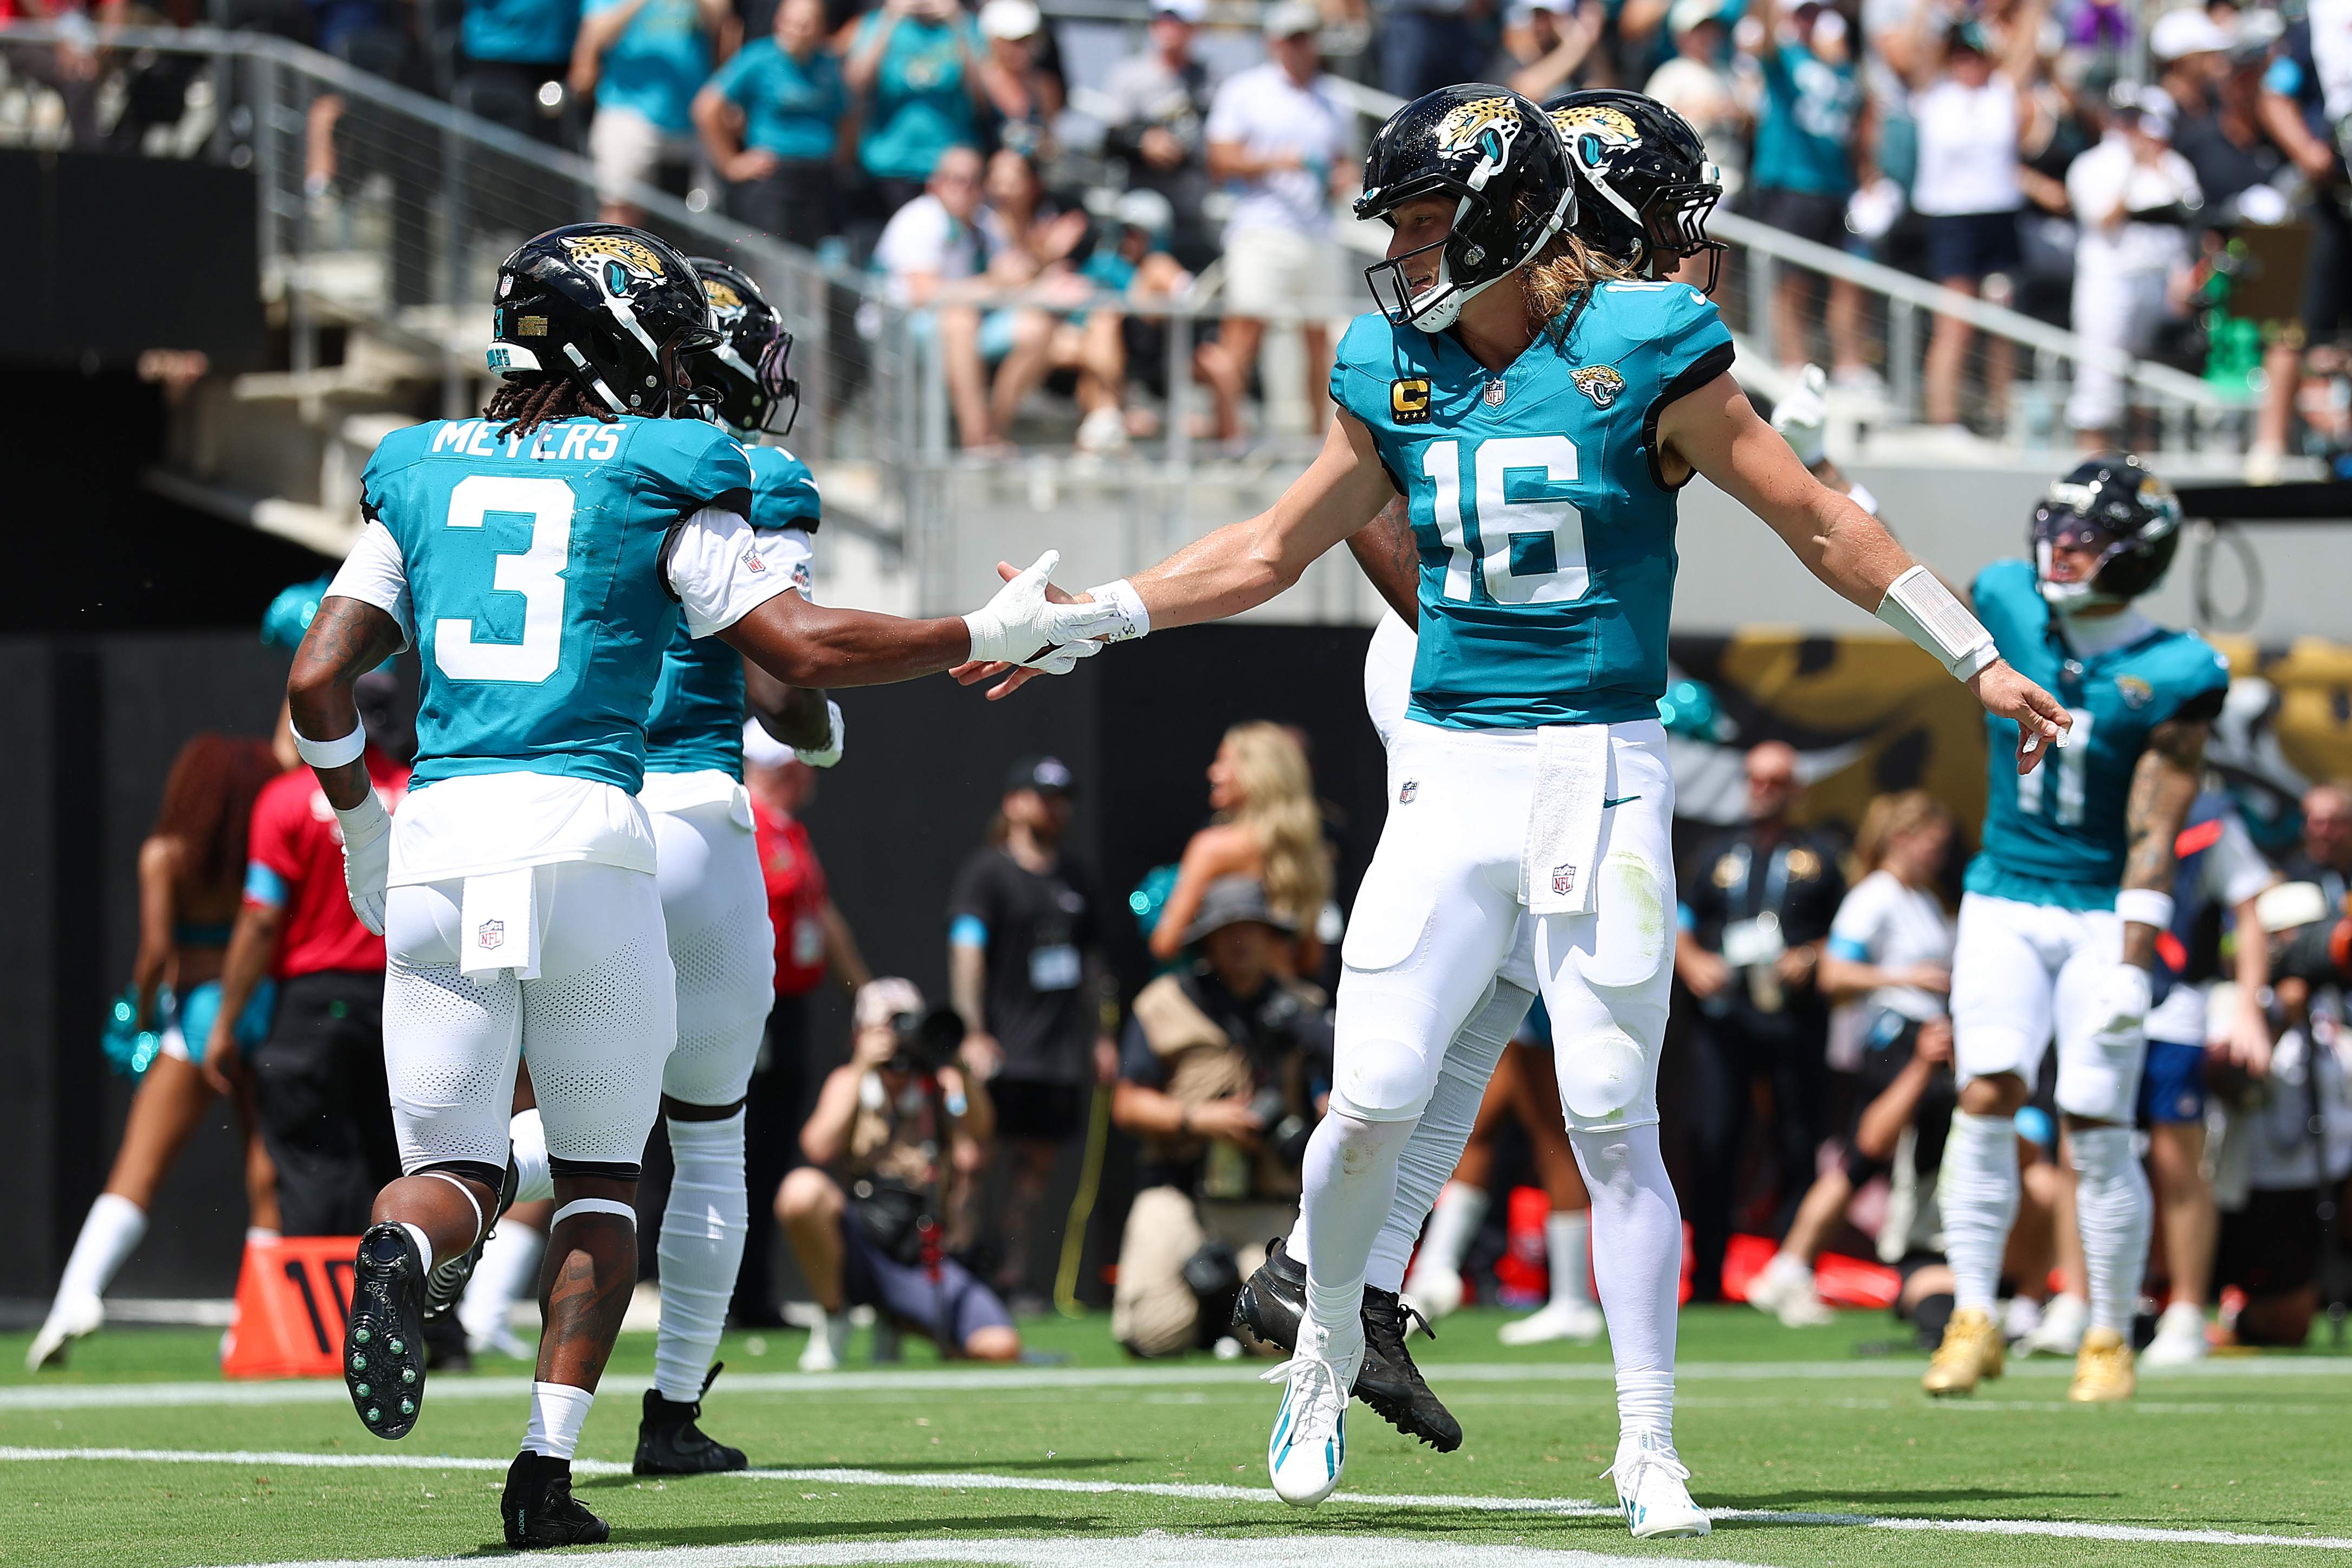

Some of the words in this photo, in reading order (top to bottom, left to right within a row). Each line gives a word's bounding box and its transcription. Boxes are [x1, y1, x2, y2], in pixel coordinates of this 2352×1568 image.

[496, 308, 503, 338] 3
[1393, 380, 1429, 411] C
[1487, 391, 1501, 402] NFL
[432, 420, 628, 460] MEYERS
[1423, 435, 1590, 605] 16
[748, 558, 764, 571] NF
[434, 475, 576, 683] 3
[1400, 791, 1412, 801] NFL
[1554, 877, 1571, 891] NFL
[481, 932, 500, 945] NFL
